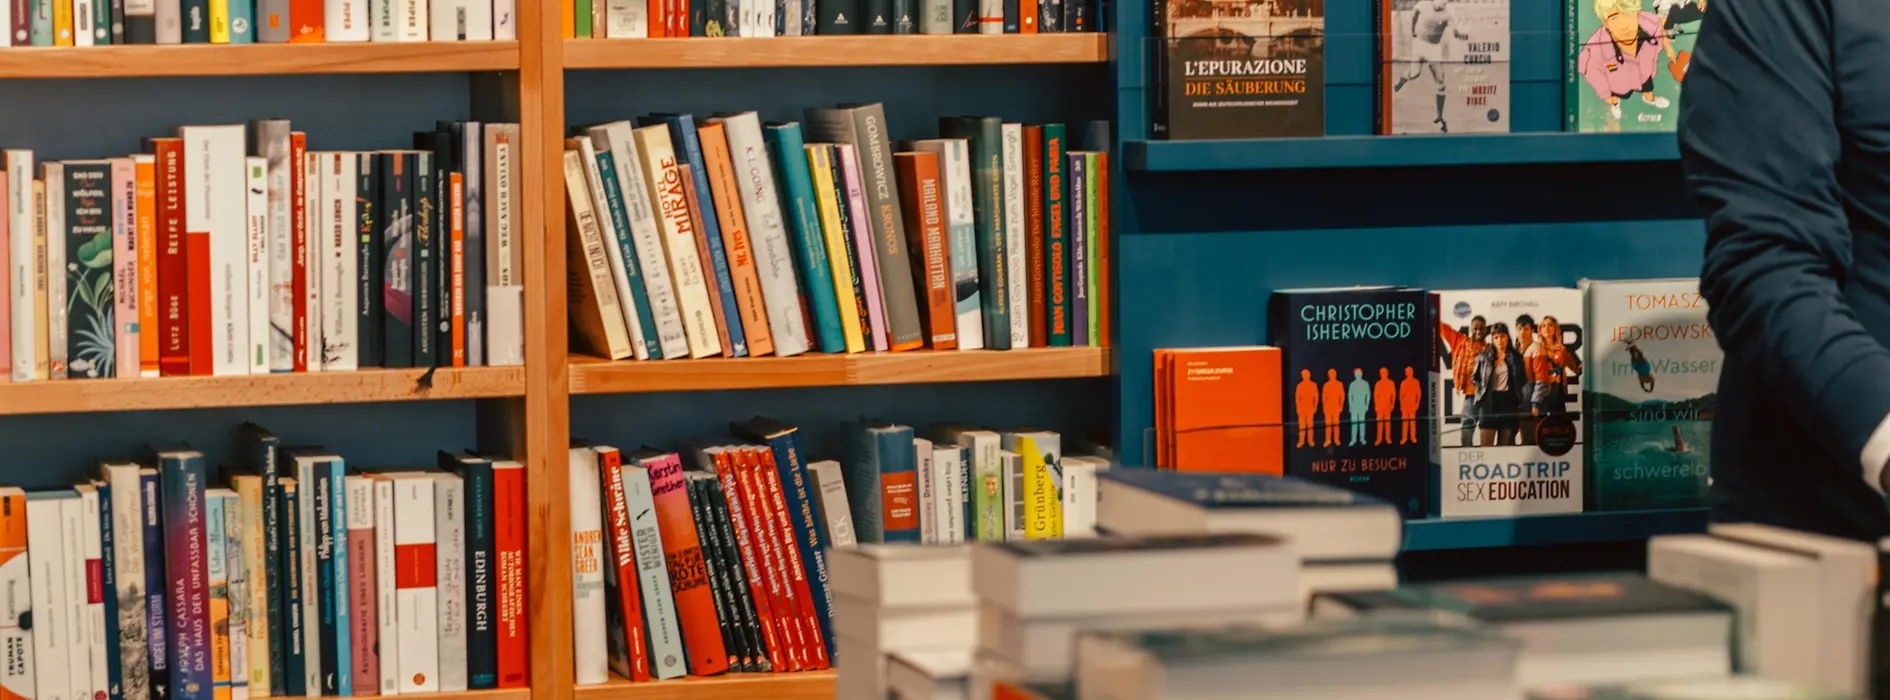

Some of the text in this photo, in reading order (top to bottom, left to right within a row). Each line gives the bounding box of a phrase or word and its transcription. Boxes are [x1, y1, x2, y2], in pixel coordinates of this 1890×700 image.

[1468, 42, 1500, 53] VALERIO
[1184, 59, 1306, 76] L'EPURAZIONE
[1184, 78, 1306, 96] DIE SÄUBERUNG
[499, 147, 507, 188] OXIANA
[656, 177, 673, 219] HOTEL
[659, 153, 692, 234] MIRAGE
[748, 166, 766, 205] GOING
[864, 114, 899, 255] GOMBROWICZ KRONOS
[1007, 173, 1018, 201] Vogel
[166, 151, 178, 254] REIFE LEISTUNG
[500, 193, 508, 221] NACH
[1030, 186, 1040, 216] blinde
[921, 178, 945, 289] MAILAND MANHATTAN
[1009, 226, 1018, 253] Reise
[1031, 218, 1040, 234] Der
[1047, 137, 1065, 334] JUAN GOYTISOLO ENGEL UND PARIA
[729, 228, 749, 267] Mr. Ives
[1300, 303, 1416, 322] CHRISTOPHER
[1625, 292, 1704, 310] TOMASZ
[1306, 322, 1411, 340] ISHERWOOD
[1648, 358, 1717, 375] Wasser
[1629, 402, 1700, 424] sind wir
[647, 461, 681, 481] Kerstin
[785, 446, 800, 472] Liebe
[1312, 457, 1407, 473] NUR ZU BESUCH
[1458, 451, 1484, 462] DER
[1458, 461, 1571, 480] ROADTRIP
[1613, 460, 1707, 480] schwerelo
[791, 471, 804, 487] die
[795, 486, 807, 499] ist
[922, 457, 930, 498] Dreamboy
[1457, 479, 1570, 502] SEX EDUCATION
[1033, 463, 1046, 531] Grünberg
[606, 465, 633, 564] Wilde Schwäne
[766, 469, 803, 581] American Boy und sein Prinz
[798, 498, 815, 528] bleibt,
[575, 544, 594, 558] SEAN
[635, 528, 652, 571] MISTER
[646, 524, 662, 569] WENIGER
[805, 527, 819, 547] Was
[186, 473, 204, 671] DAS HAUS DER UNFASSBAR SCHÖNEN
[256, 563, 264, 593] Taylor
[575, 558, 598, 574] GREER
[670, 565, 705, 582] ROTE
[811, 549, 828, 583] Grieser
[359, 581, 367, 606] EINES
[475, 550, 487, 631] EDINBURGH
[151, 594, 166, 670] ENGEL IM STURM
[176, 578, 190, 673] JOSEPH CASSARA
[256, 597, 265, 639] Richard
[7, 636, 15, 677] TRUMAN
[16, 636, 25, 675] CAPOTE
[359, 609, 370, 675] AUTOBIOGRAFIE
